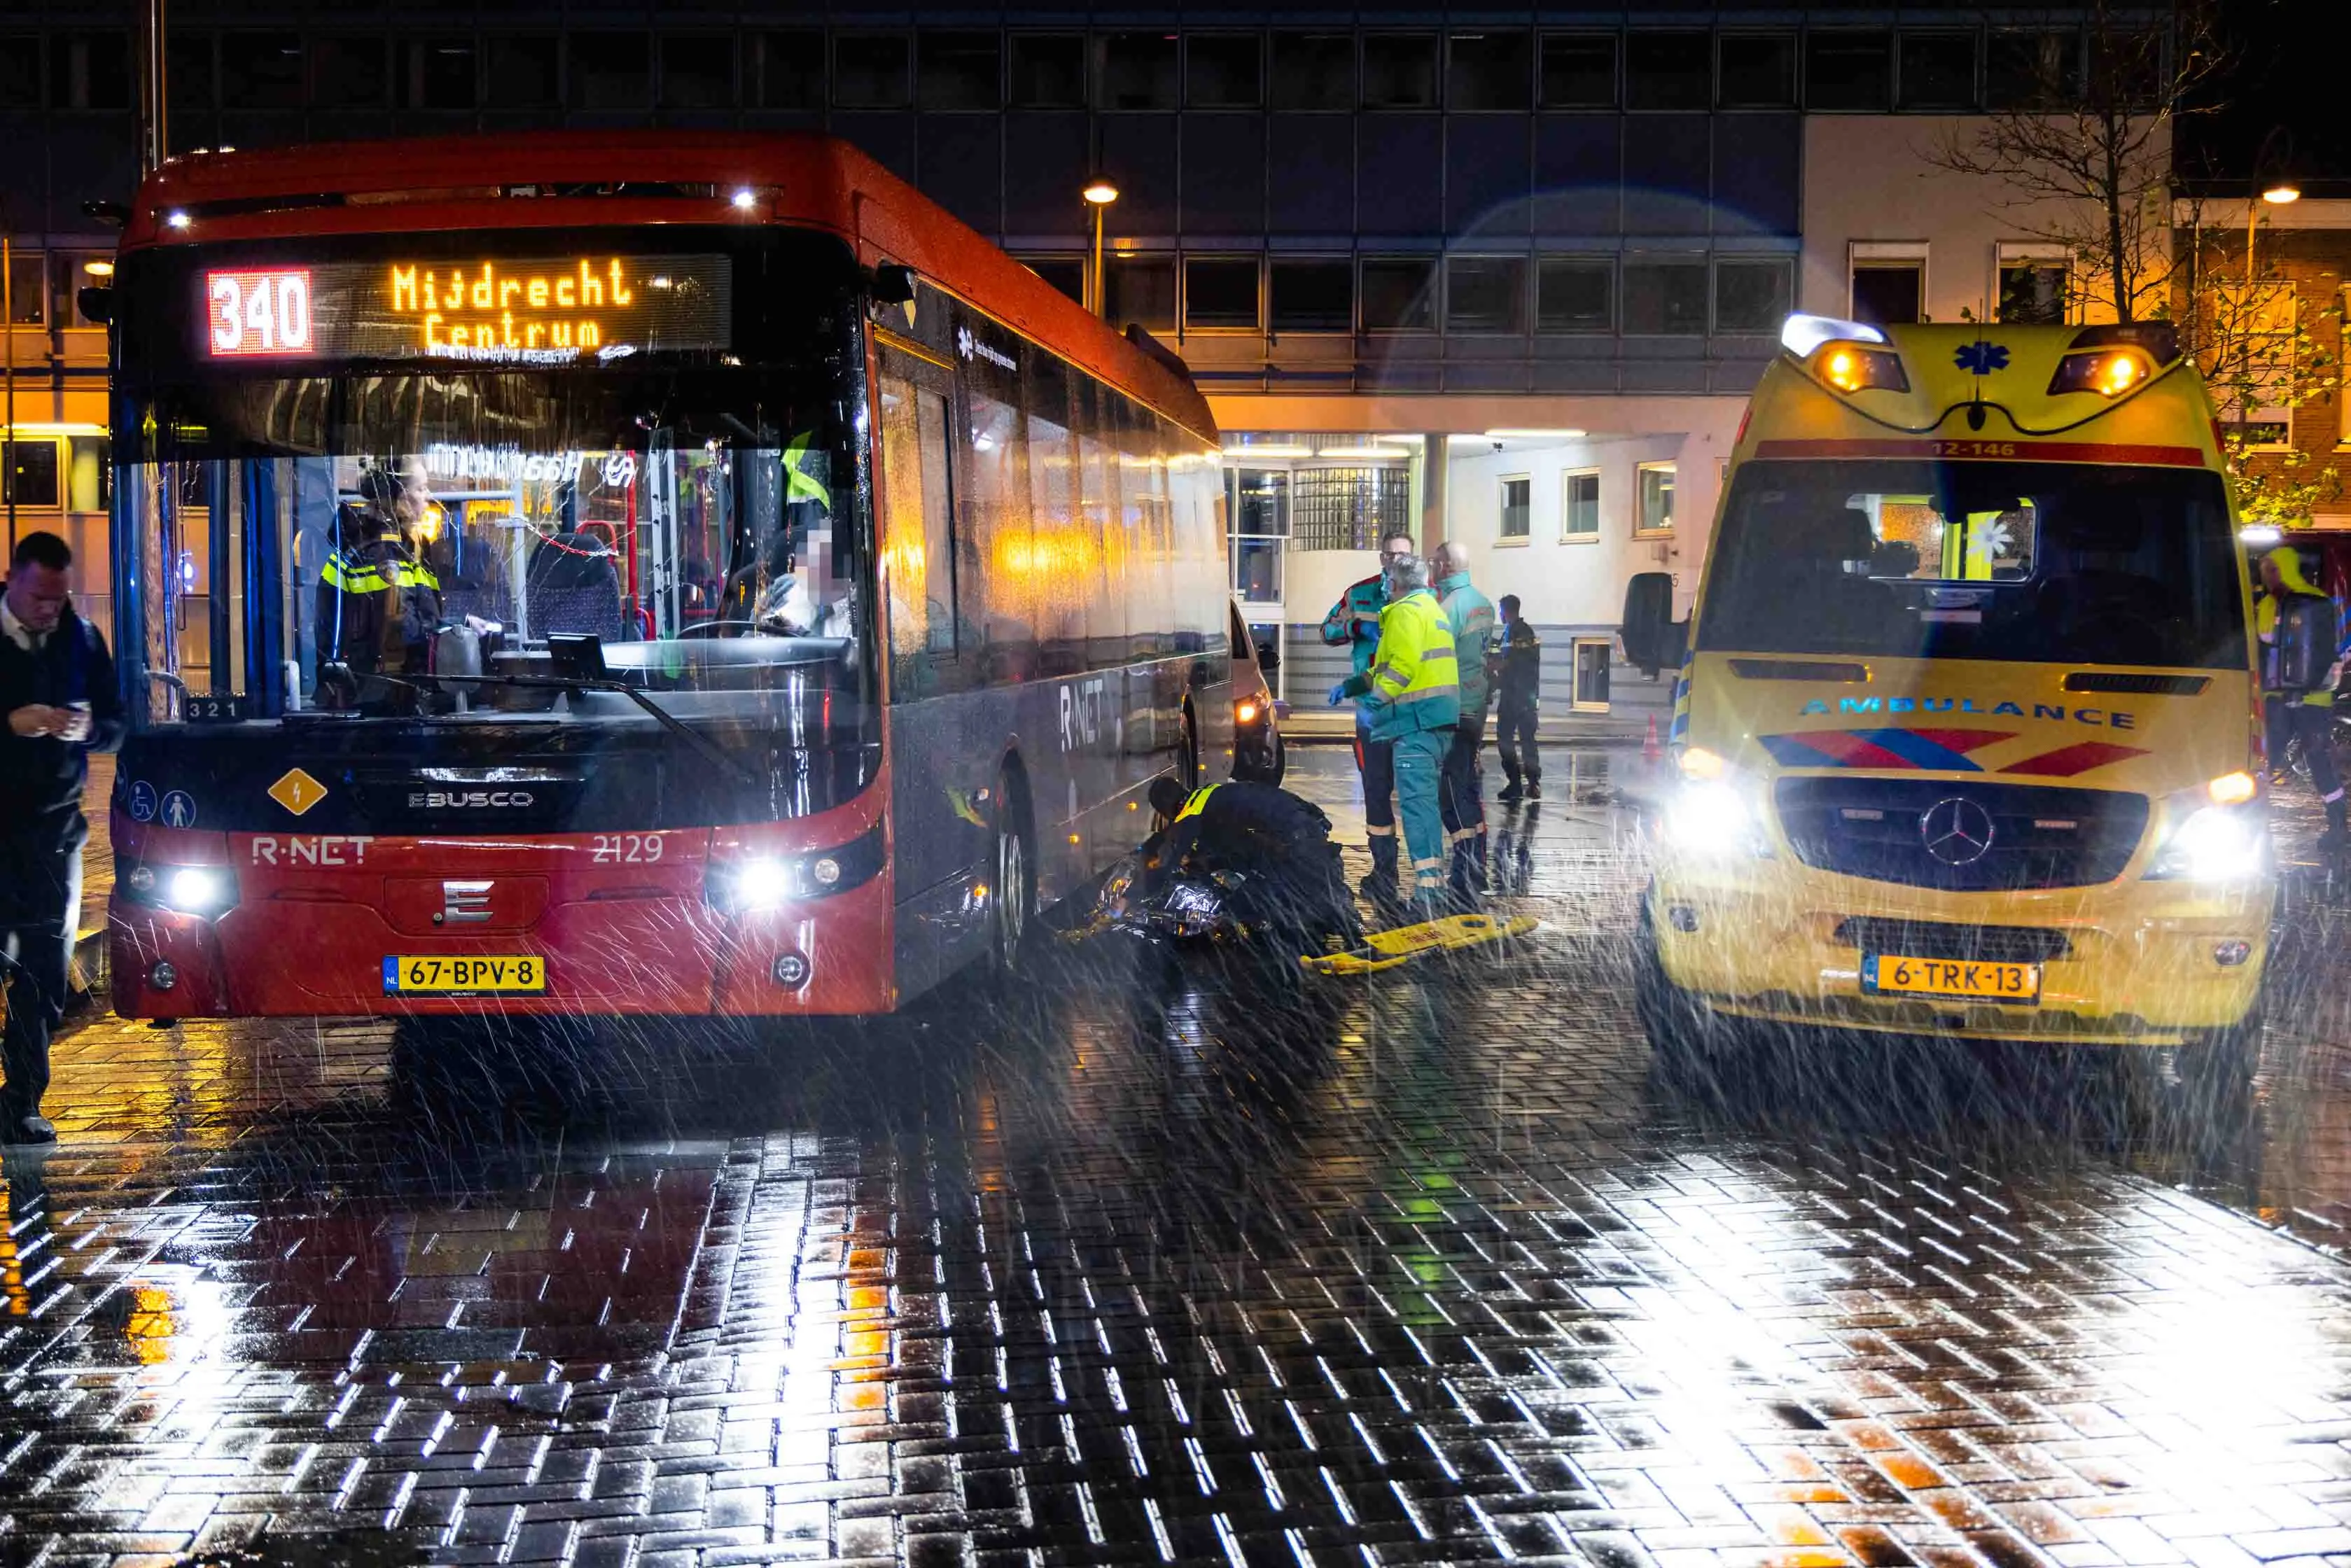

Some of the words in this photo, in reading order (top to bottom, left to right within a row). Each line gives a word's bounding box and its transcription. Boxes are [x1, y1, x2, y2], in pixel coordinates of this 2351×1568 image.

[393, 258, 632, 311] Mijdrecht
[211, 276, 307, 350] 340
[424, 311, 600, 349] Centrum
[1932, 442, 2015, 456] 12-146
[190, 703, 200, 718] 3
[207, 702, 218, 717] 2
[228, 701, 236, 716] 1
[1798, 697, 2136, 730] AMBULANCE
[408, 792, 533, 807] EBUSCO
[593, 834, 664, 863] 2129
[386, 976, 398, 985] NL
[410, 960, 533, 985] 67-BPV-8
[1865, 974, 1877, 983] NL
[1894, 961, 2023, 992] 6-TRK-13
